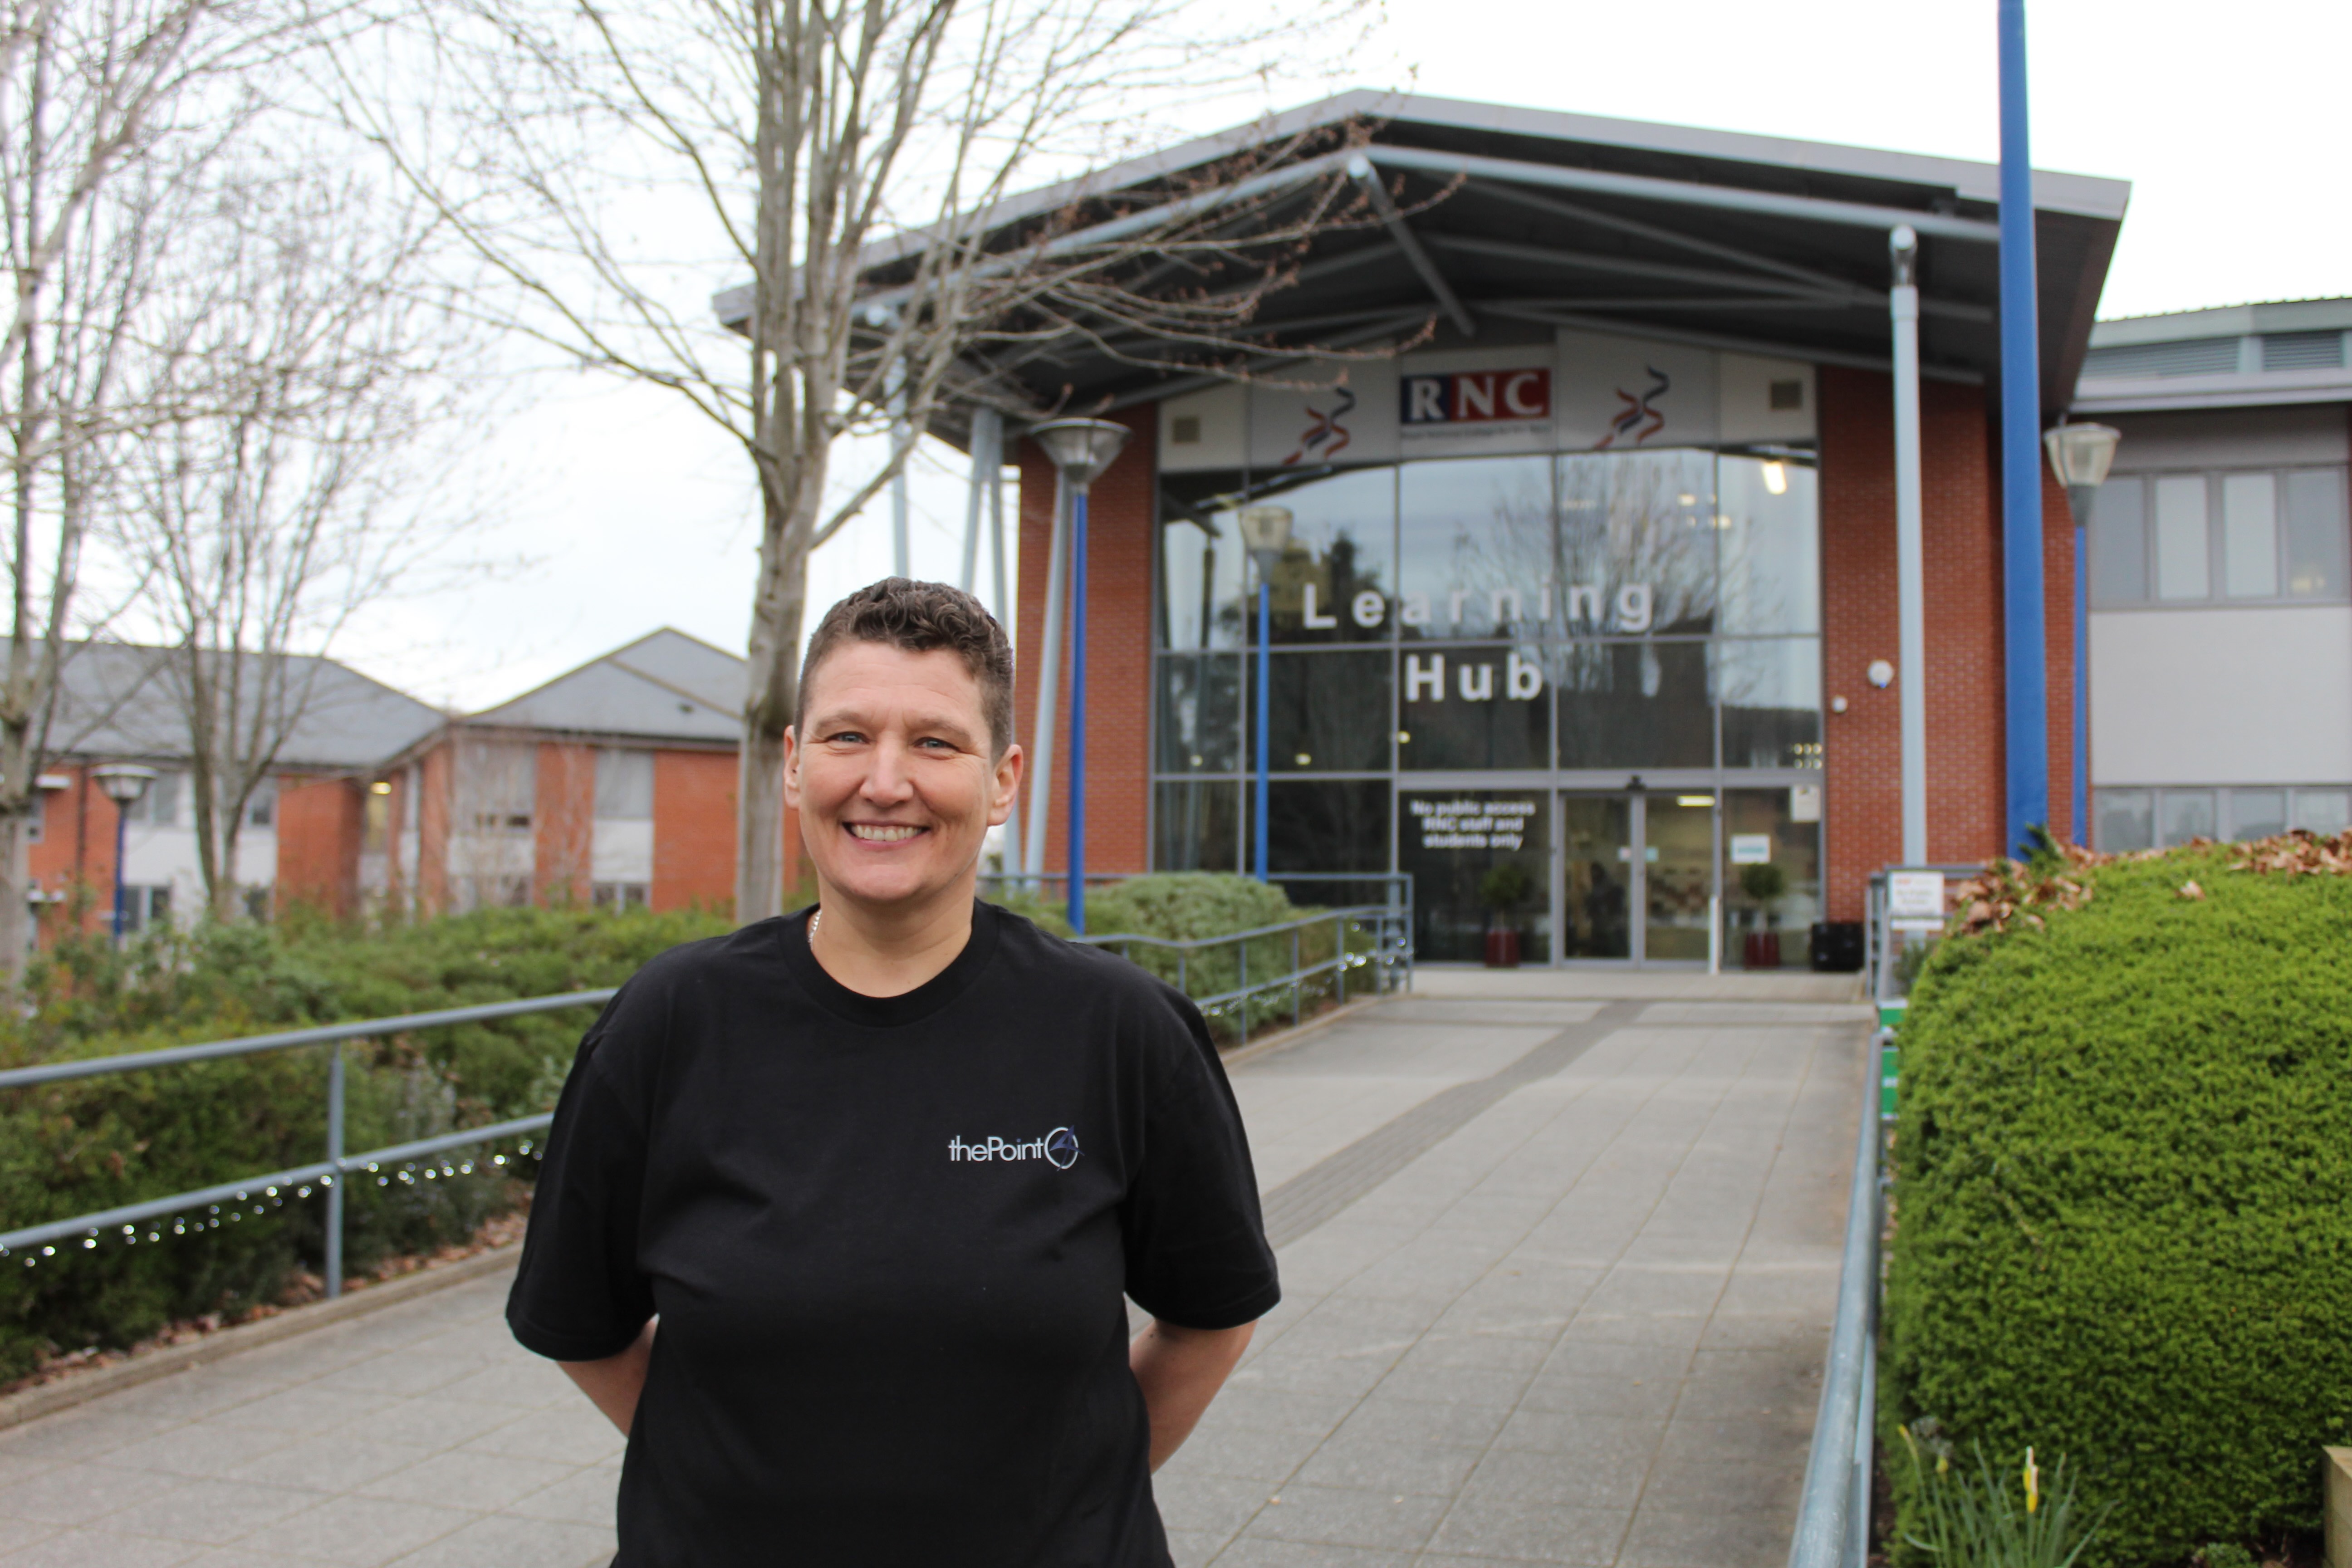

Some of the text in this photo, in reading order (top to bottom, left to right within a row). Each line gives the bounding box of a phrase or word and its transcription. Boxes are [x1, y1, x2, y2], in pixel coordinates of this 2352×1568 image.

[1410, 372, 1543, 421] RNC
[1302, 577, 1654, 633] Learning
[1405, 652, 1543, 702] Hub
[1411, 799, 1536, 817] No public access
[1422, 816, 1524, 831] RNC staff and
[1422, 833, 1524, 851] students only
